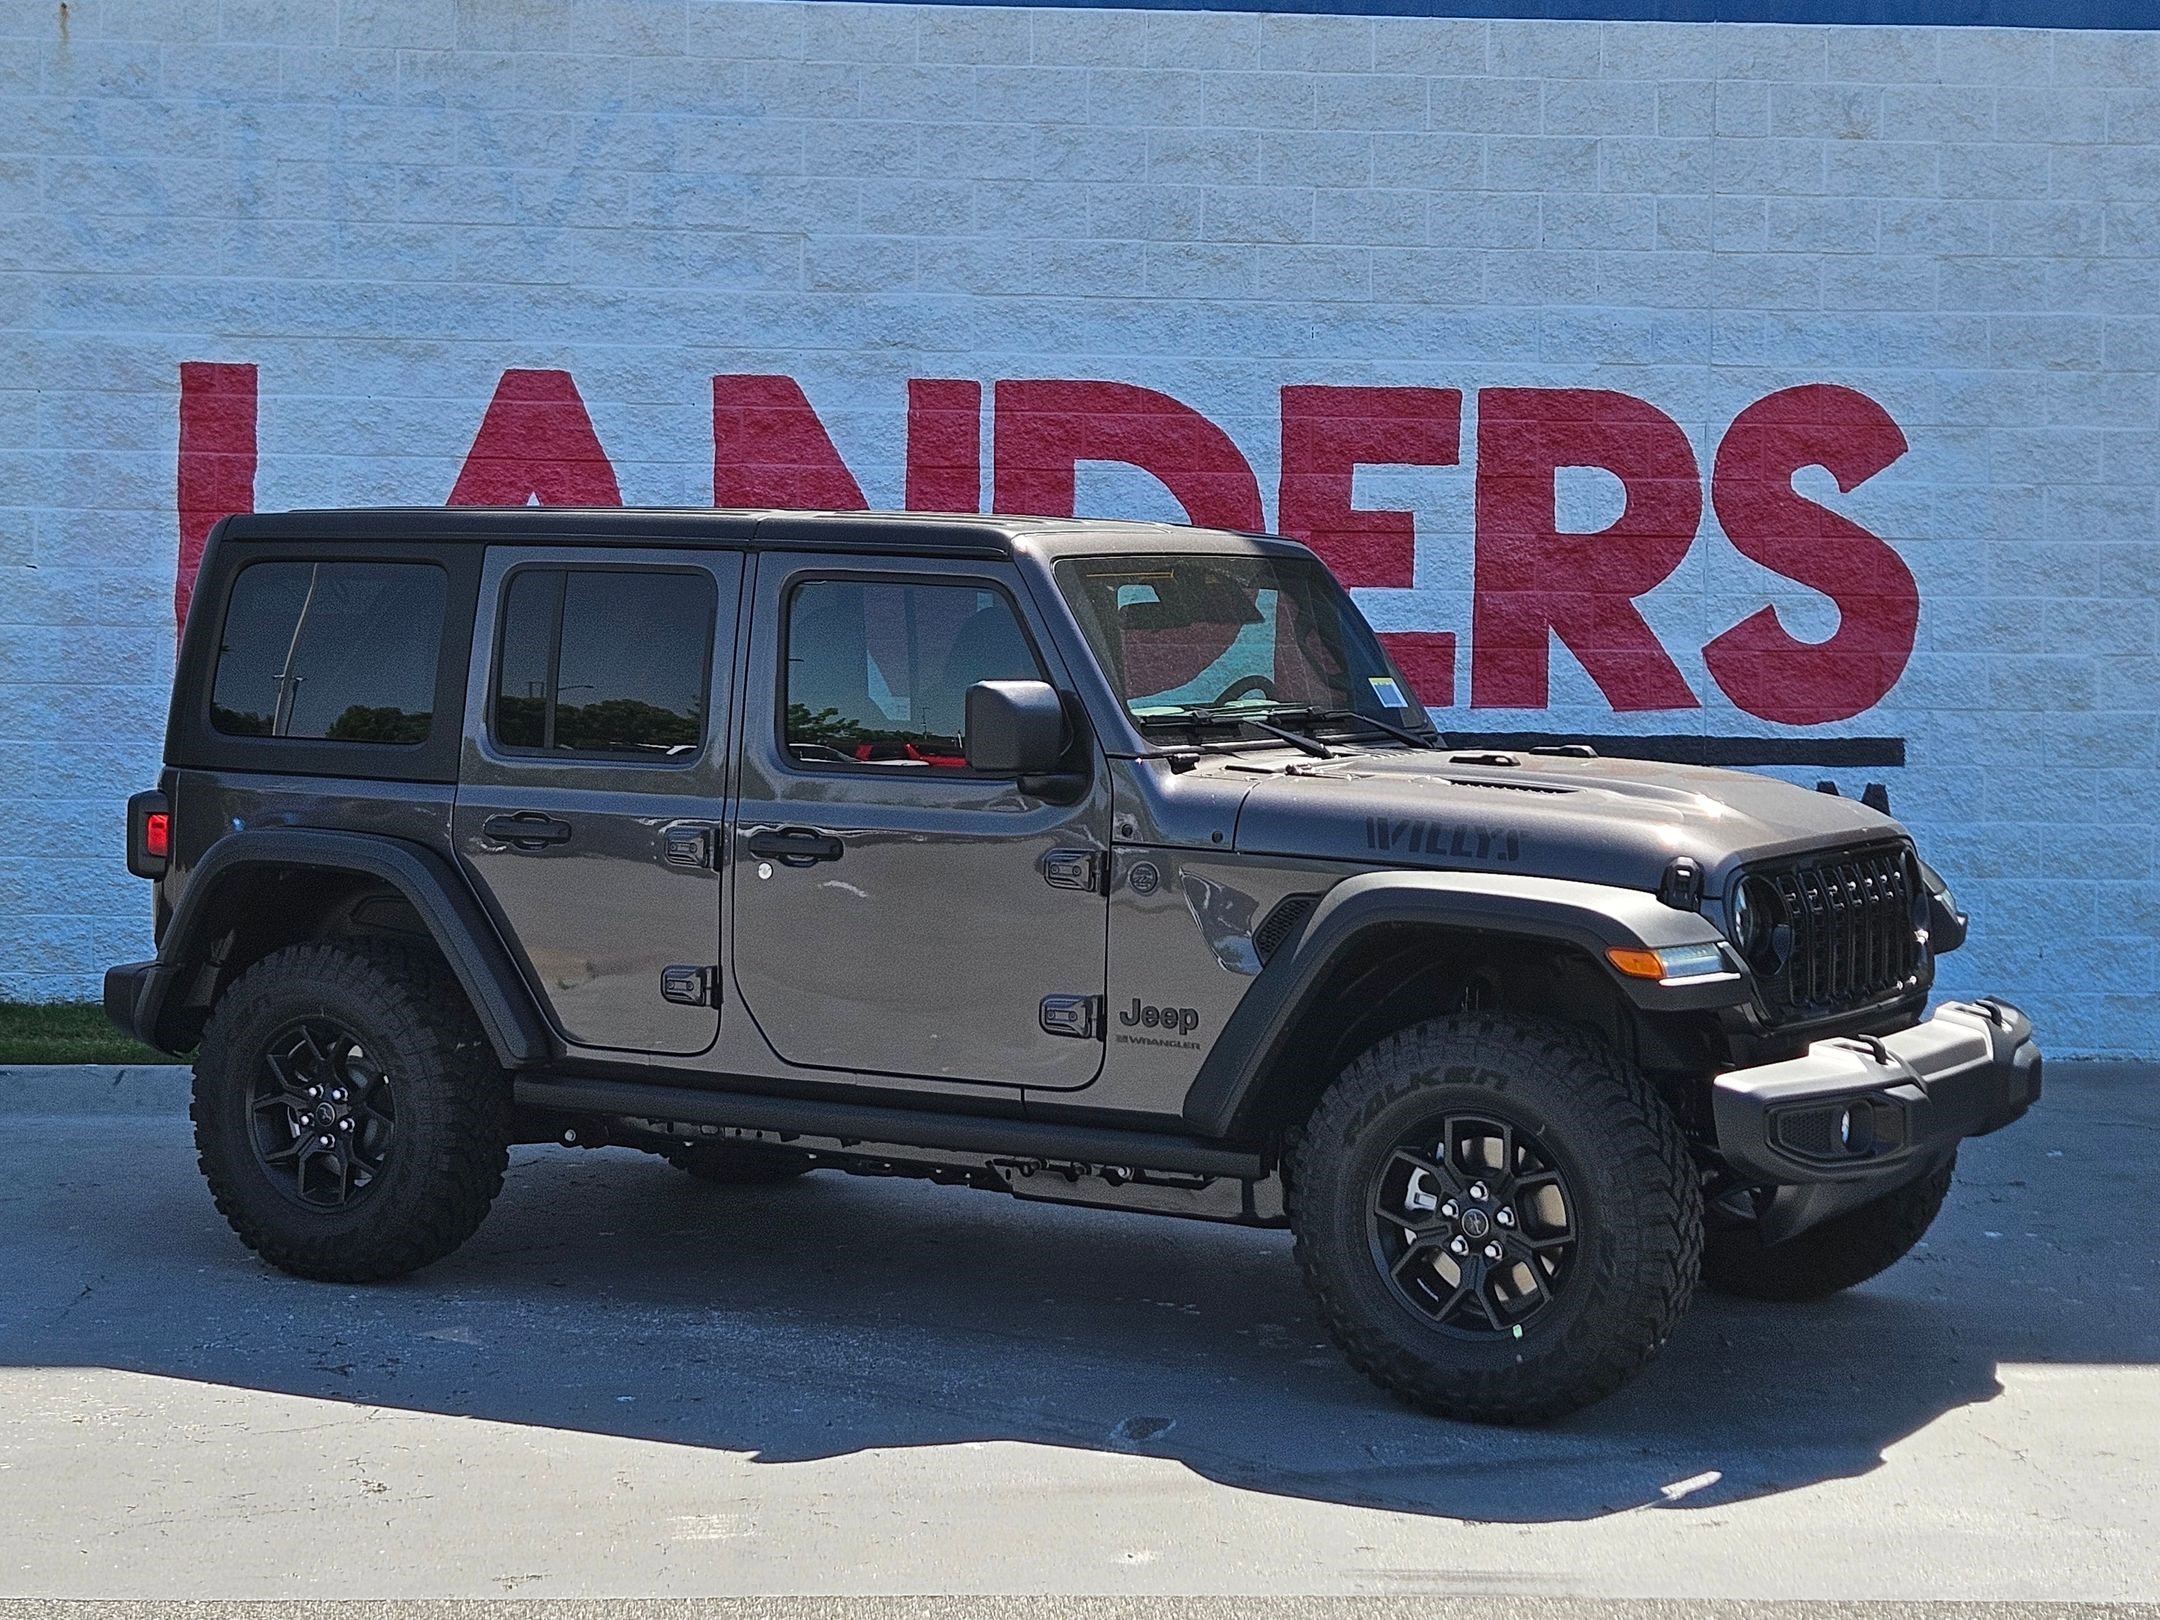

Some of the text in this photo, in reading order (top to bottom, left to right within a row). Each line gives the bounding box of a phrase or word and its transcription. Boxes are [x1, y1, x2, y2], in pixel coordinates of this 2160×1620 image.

[1366, 816, 1528, 862] WILLYS
[1120, 998, 1199, 1035] Jeep
[1129, 1035, 1200, 1050] WRANGLER
